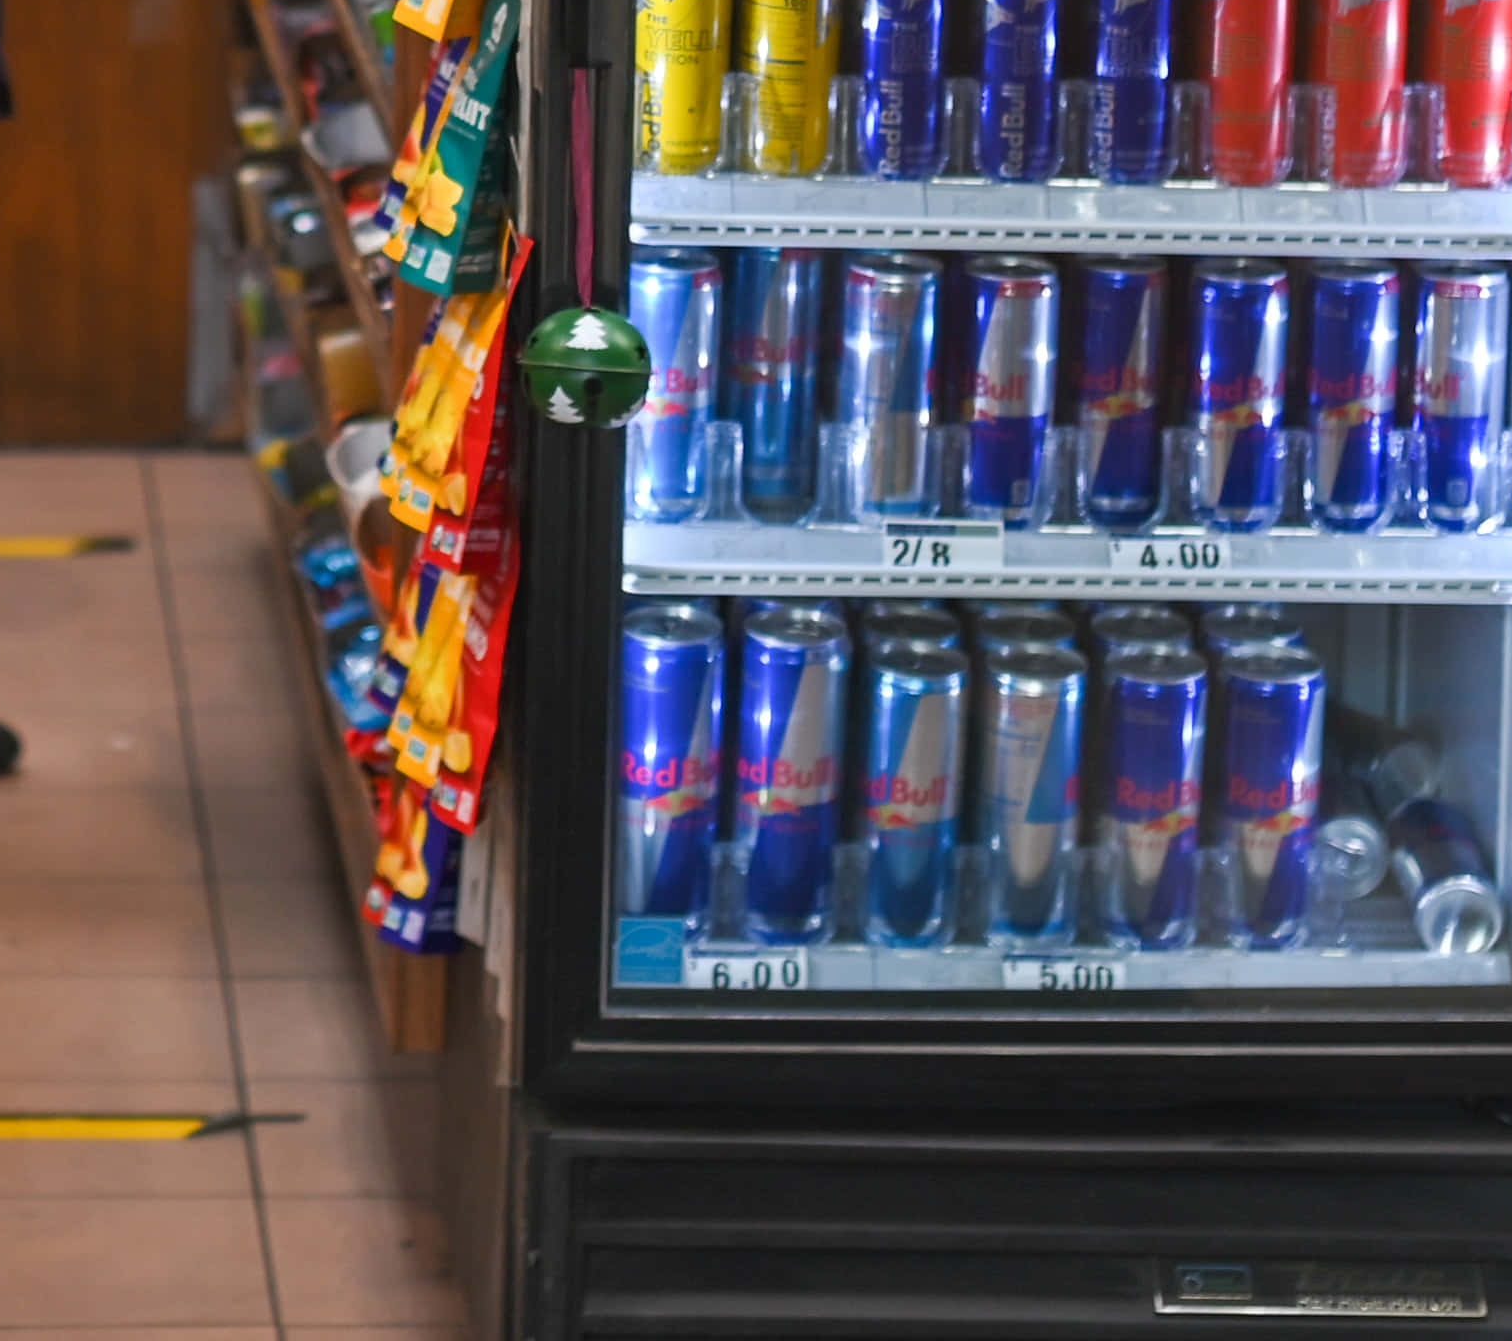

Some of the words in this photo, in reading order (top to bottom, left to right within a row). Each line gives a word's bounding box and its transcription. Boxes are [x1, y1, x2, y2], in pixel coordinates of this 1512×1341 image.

[644, 27, 724, 51] YELL
[879, 79, 904, 123] Bull
[1001, 83, 1026, 129] Bull
[879, 121, 903, 177] Red
[1000, 130, 1024, 179] Red
[891, 538, 951, 567] 2/8
[1139, 542, 1221, 569] 4.00
[620, 751, 676, 787] Red
[737, 758, 769, 784] ed
[891, 776, 949, 807] Bull
[1117, 777, 1175, 808] Red
[1228, 776, 1287, 809] Red
[711, 959, 801, 990] 6.00
[1040, 964, 1114, 990] 5.00
